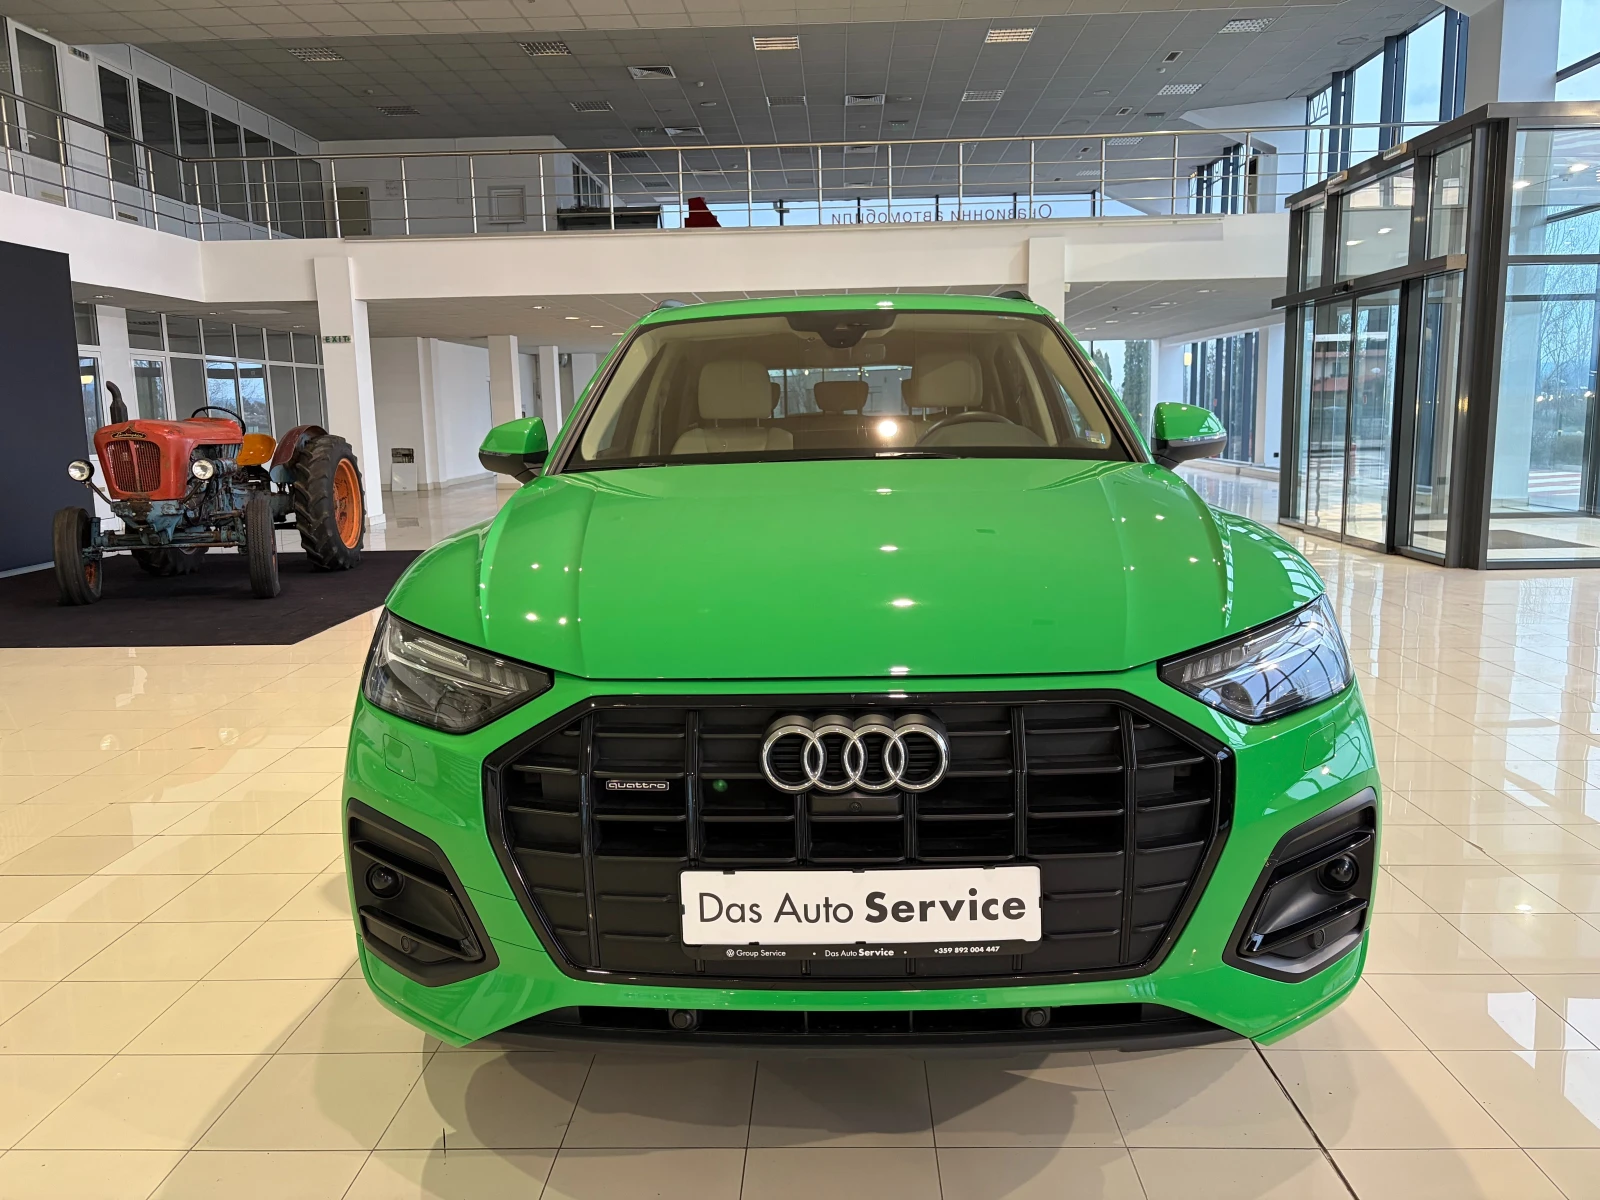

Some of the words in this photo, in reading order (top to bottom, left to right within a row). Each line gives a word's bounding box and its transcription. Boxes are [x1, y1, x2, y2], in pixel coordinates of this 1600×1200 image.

[325, 335, 348, 343] EXIT
[608, 782, 666, 790] quattro
[699, 892, 763, 923] Das
[773, 892, 854, 924] Auto
[864, 887, 1026, 924] Service
[824, 949, 840, 957] Das
[840, 949, 858, 957] Auto
[858, 948, 895, 957] Service
[985, 945, 1001, 953] 447
[736, 949, 759, 958] Group
[760, 949, 787, 957] Service
